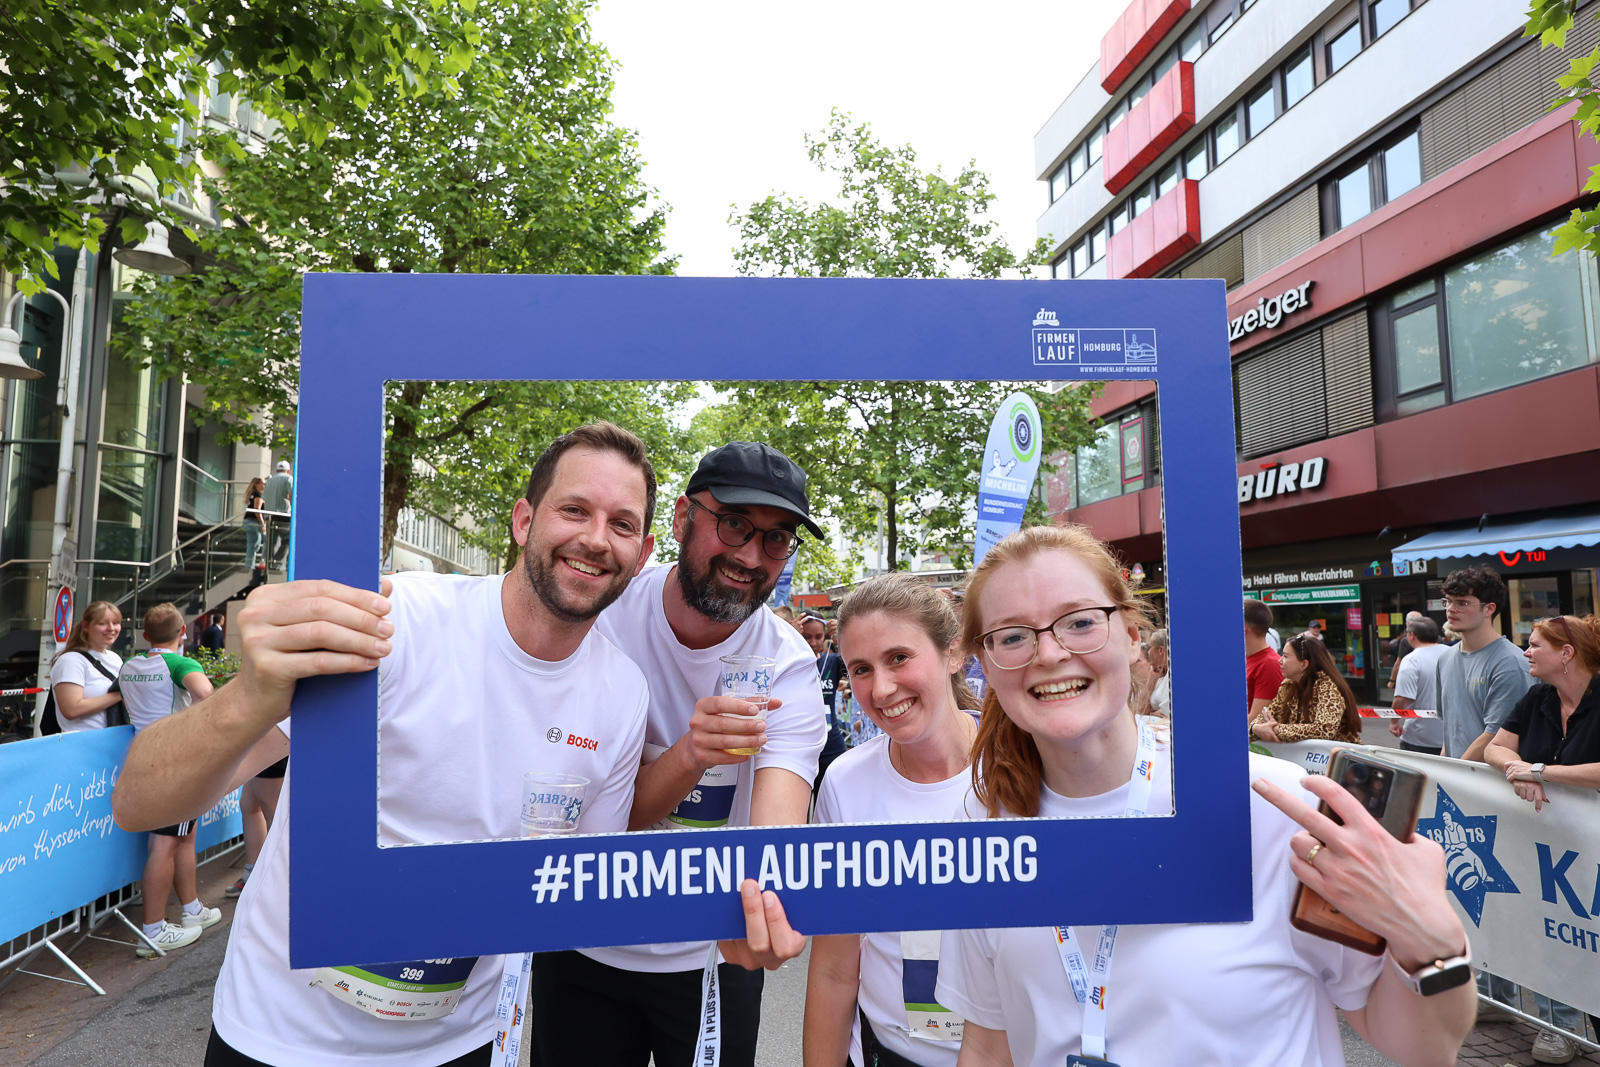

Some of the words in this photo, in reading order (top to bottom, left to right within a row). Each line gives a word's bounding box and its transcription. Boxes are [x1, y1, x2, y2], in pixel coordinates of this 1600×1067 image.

[1036, 308, 1057, 320] dm
[1037, 333, 1075, 343] FIRMEN
[1038, 345, 1075, 360] LAUF
[1083, 343, 1121, 352] HOMBURG
[984, 477, 1027, 493] MICHELIN
[1525, 550, 1546, 562] TUI
[1253, 574, 1272, 585] Hotel
[1274, 572, 1299, 584] Fähren
[1301, 568, 1354, 582] Kreuzfahrten
[120, 673, 164, 682] SCHAEFFLER
[566, 733, 599, 751] BOSCH
[1137, 760, 1149, 776] dm
[42, 783, 75, 817] dich
[75, 767, 107, 818] jetzt
[1426, 828, 1444, 844] 18
[1465, 827, 1486, 843] 78
[0, 853, 26, 875] von
[531, 835, 1038, 904] #FIRMENLAUFHOMBURG
[1543, 916, 1600, 954] ECHT
[1067, 955, 1078, 971] LAUF
[400, 967, 425, 981] 399
[337, 979, 350, 989] dm
[1090, 986, 1101, 1005] dm
[516, 1008, 524, 1025] dm
[706, 1001, 716, 1025] PLUS
[706, 1026, 716, 1034] N
[494, 1030, 503, 1047] dm
